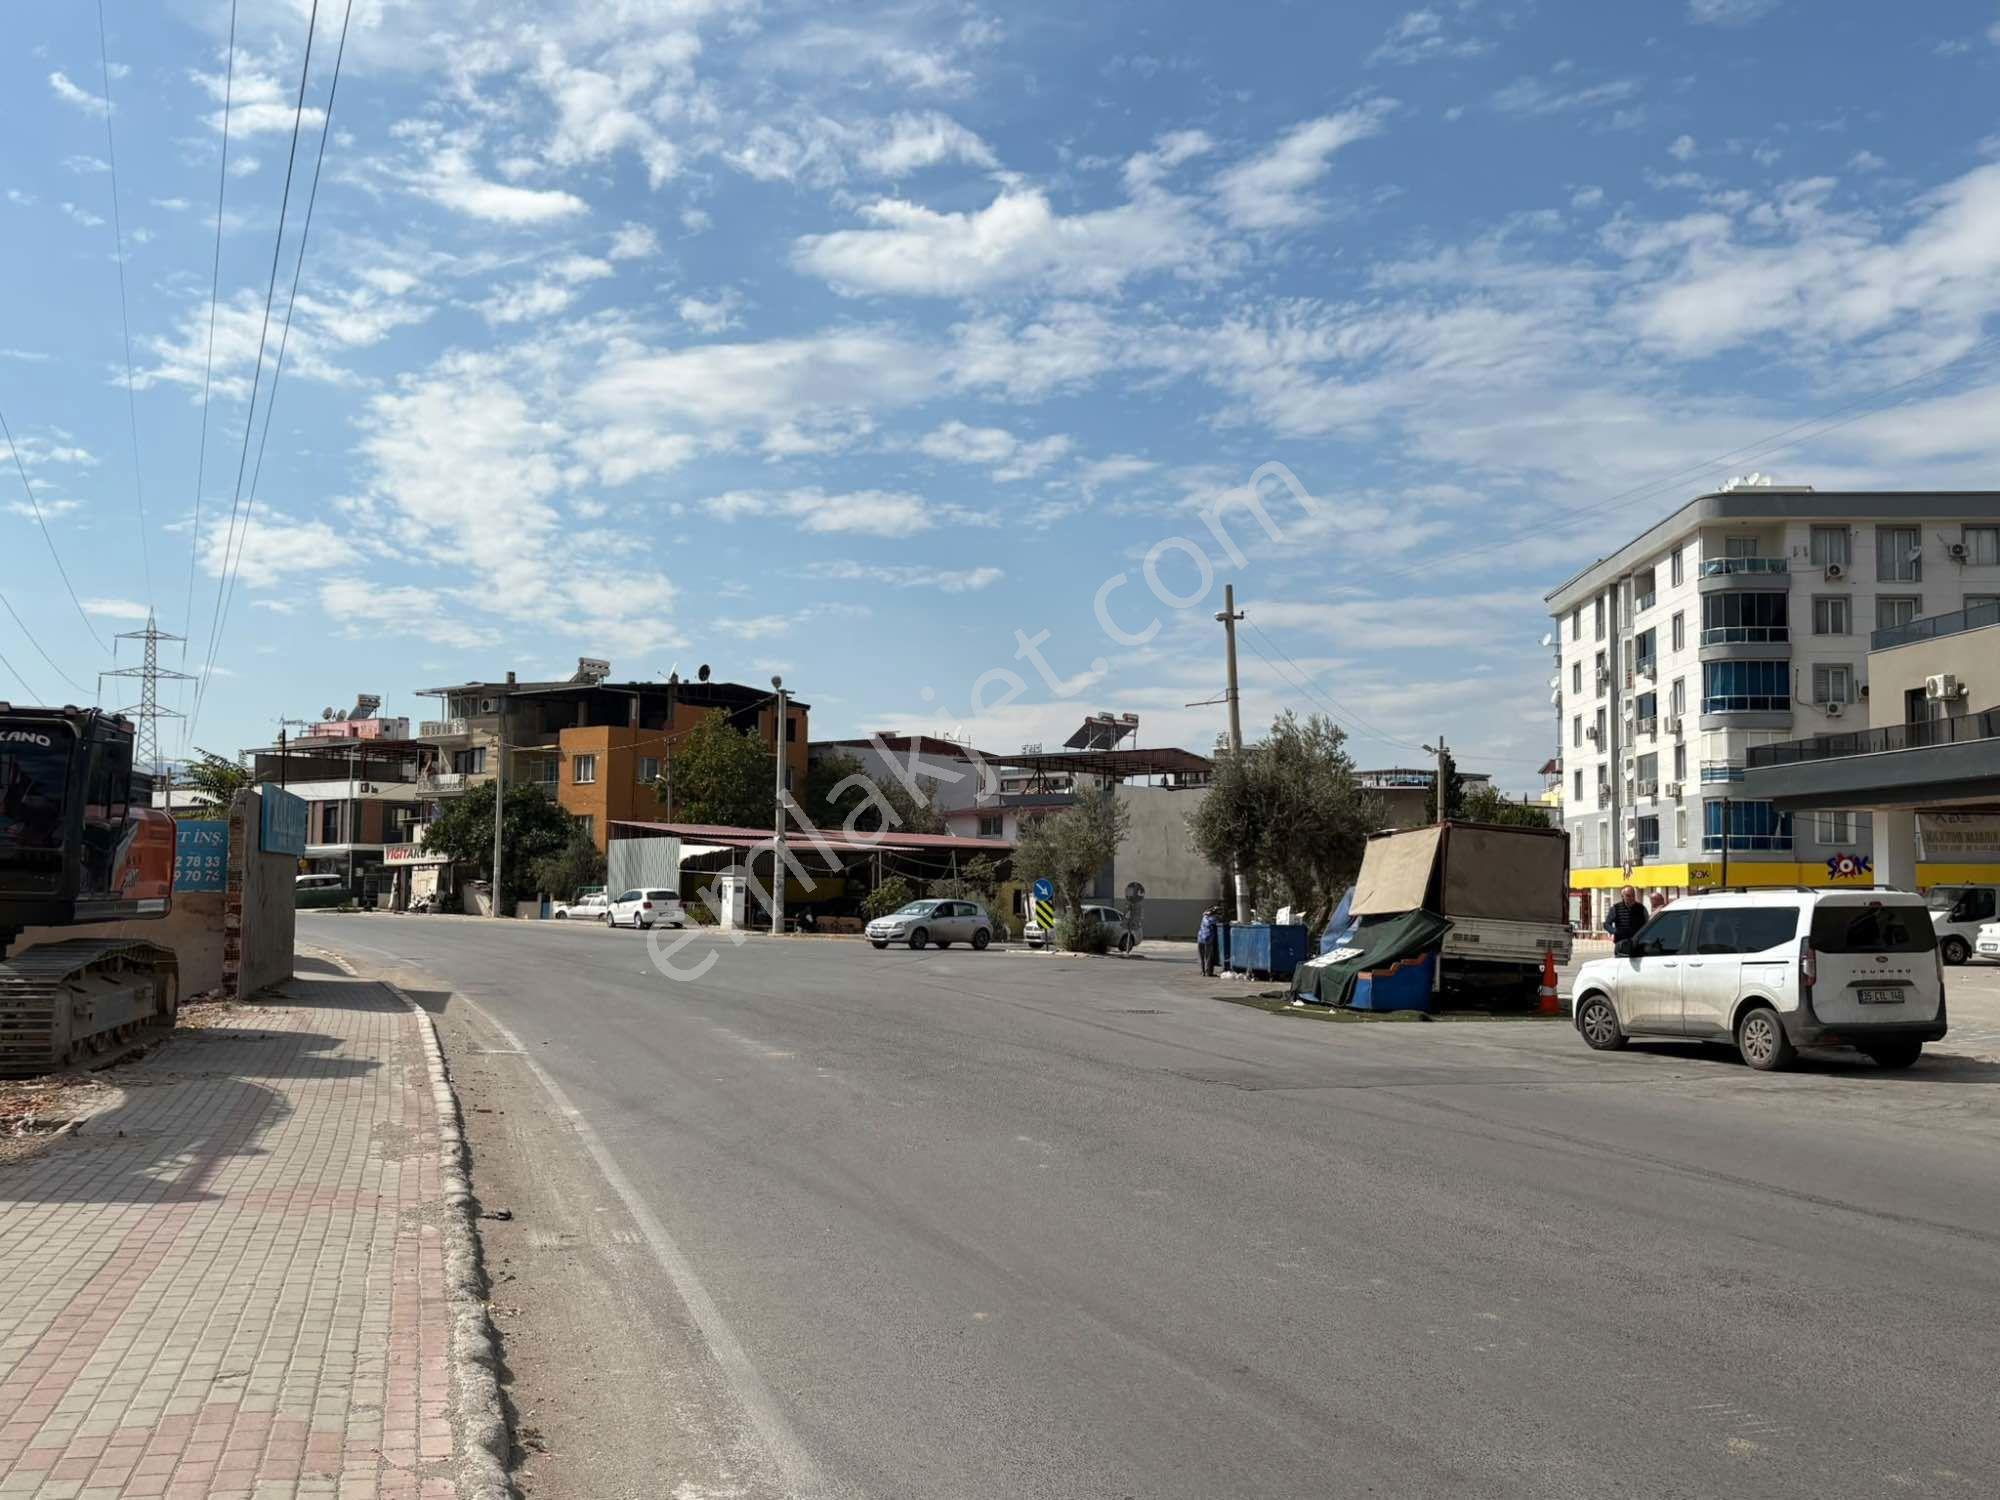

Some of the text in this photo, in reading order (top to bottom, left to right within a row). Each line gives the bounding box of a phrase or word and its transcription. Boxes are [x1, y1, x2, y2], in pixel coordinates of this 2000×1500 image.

[186, 856, 200, 867] 78
[1827, 853, 1872, 880] ŞOK
[185, 871, 200, 881] 70
